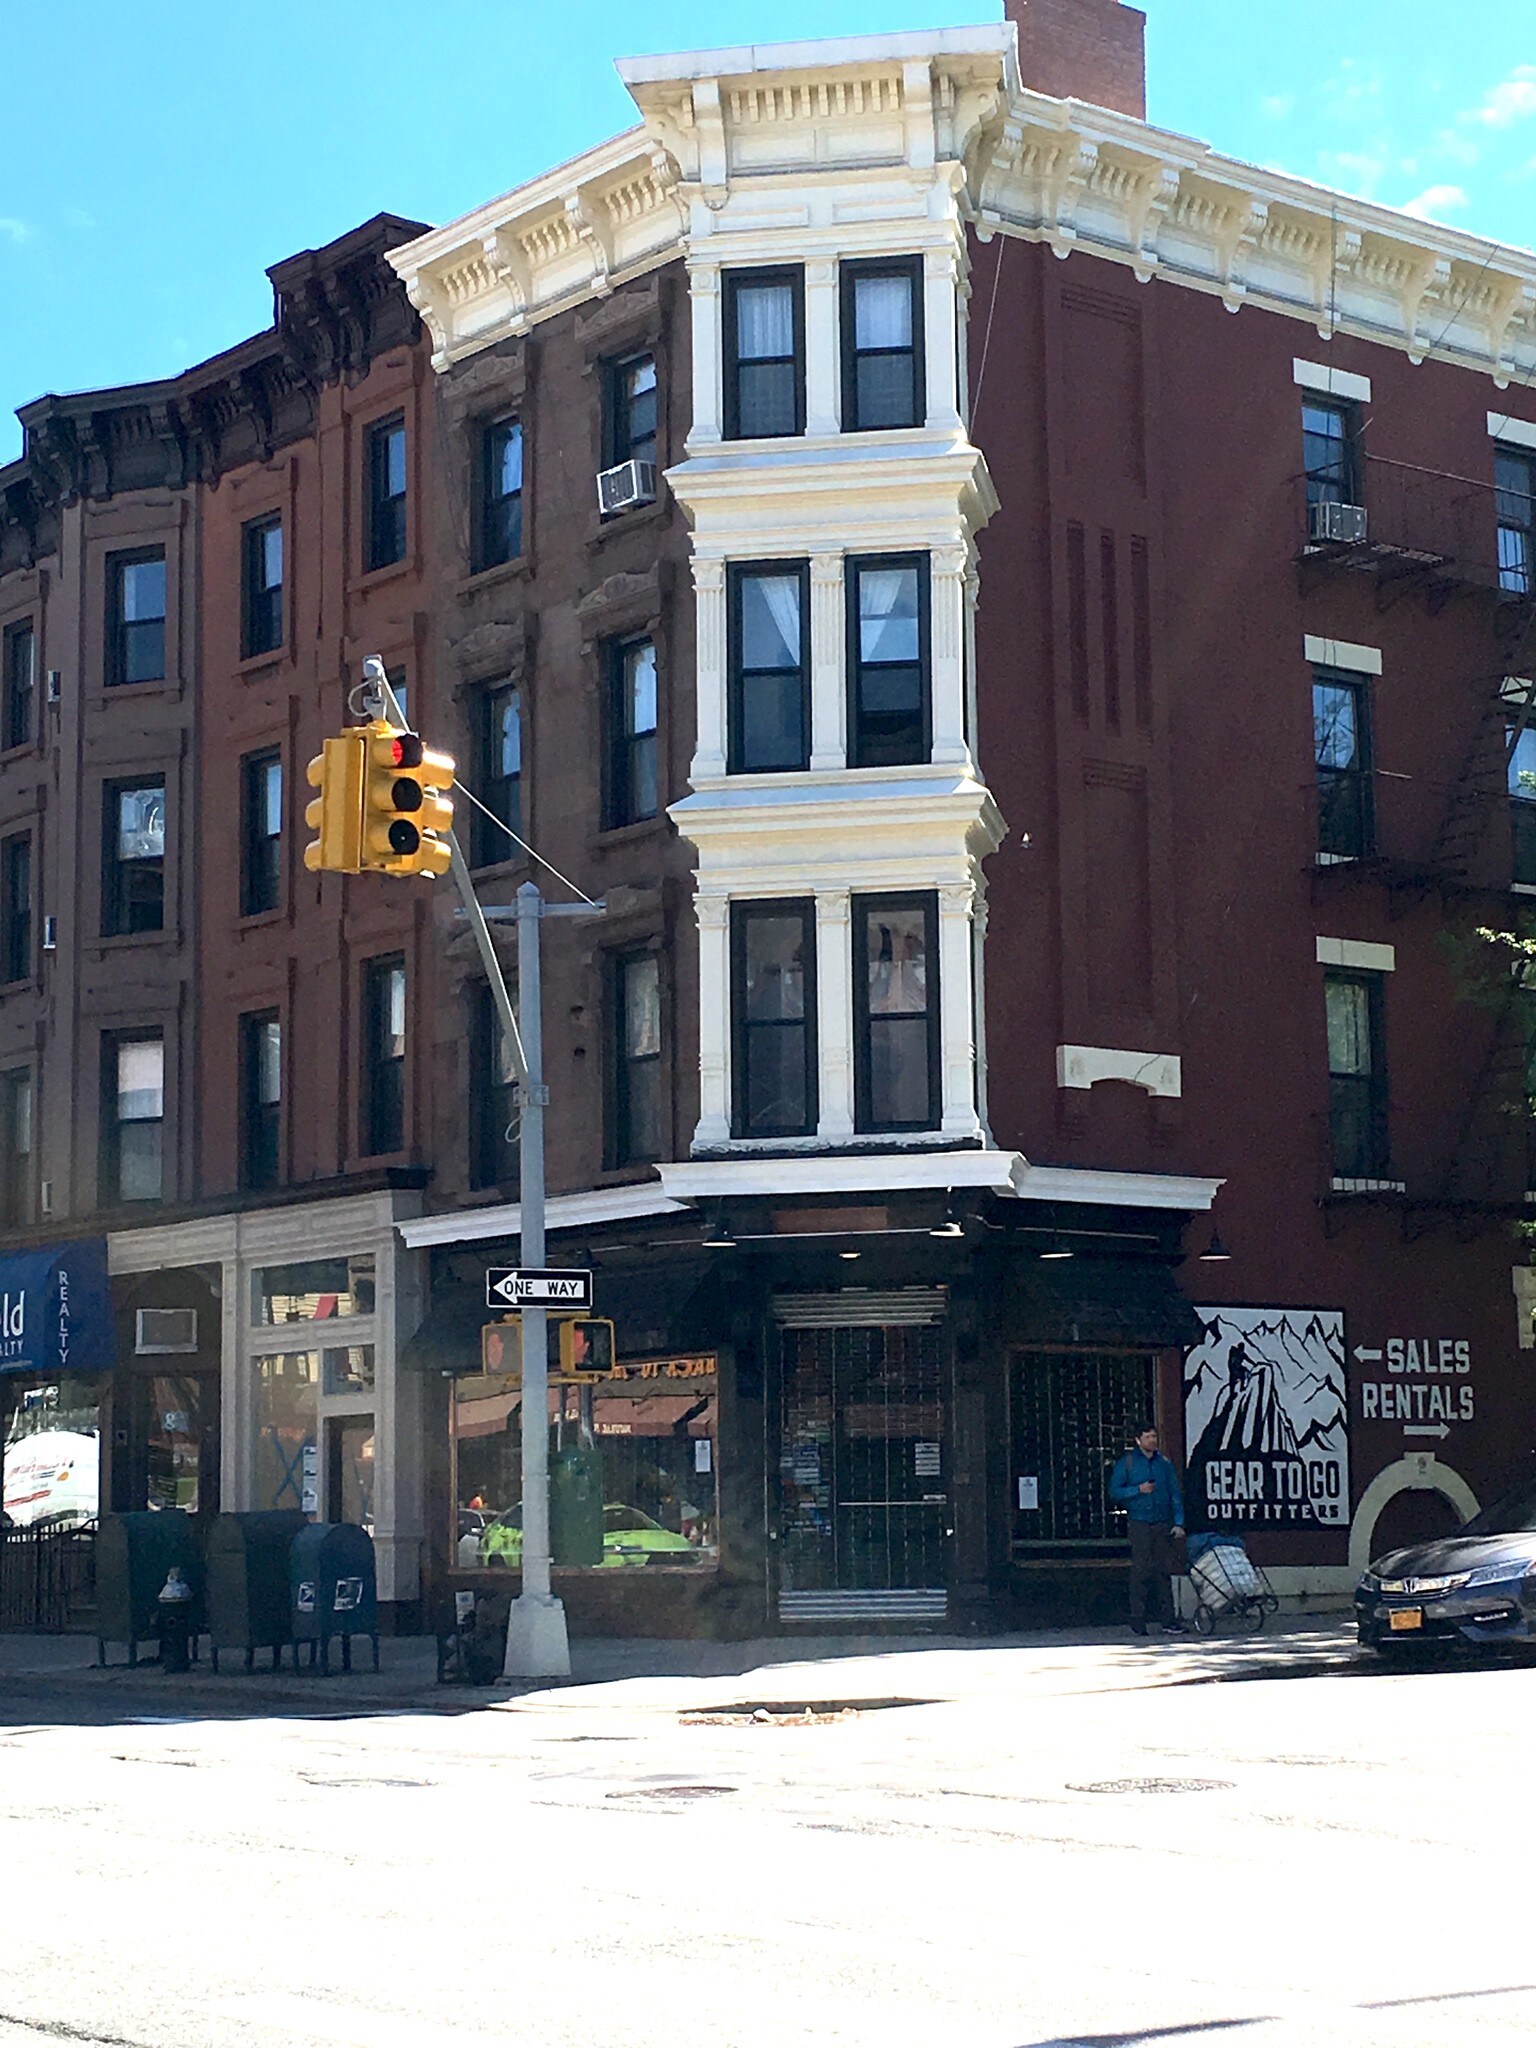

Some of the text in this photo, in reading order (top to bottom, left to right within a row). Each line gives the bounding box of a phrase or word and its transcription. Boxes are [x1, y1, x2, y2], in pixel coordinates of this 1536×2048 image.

[504, 1280, 578, 1296] ONE WAY
[0, 1289, 26, 1338] ld
[58, 1270, 70, 1364] REALTY
[1386, 1338, 1471, 1374] SALES
[1362, 1382, 1475, 1421] RENTALS
[1205, 1460, 1340, 1500] GEAR TO GO
[1207, 1502, 1339, 1519] OUTFITTERS
